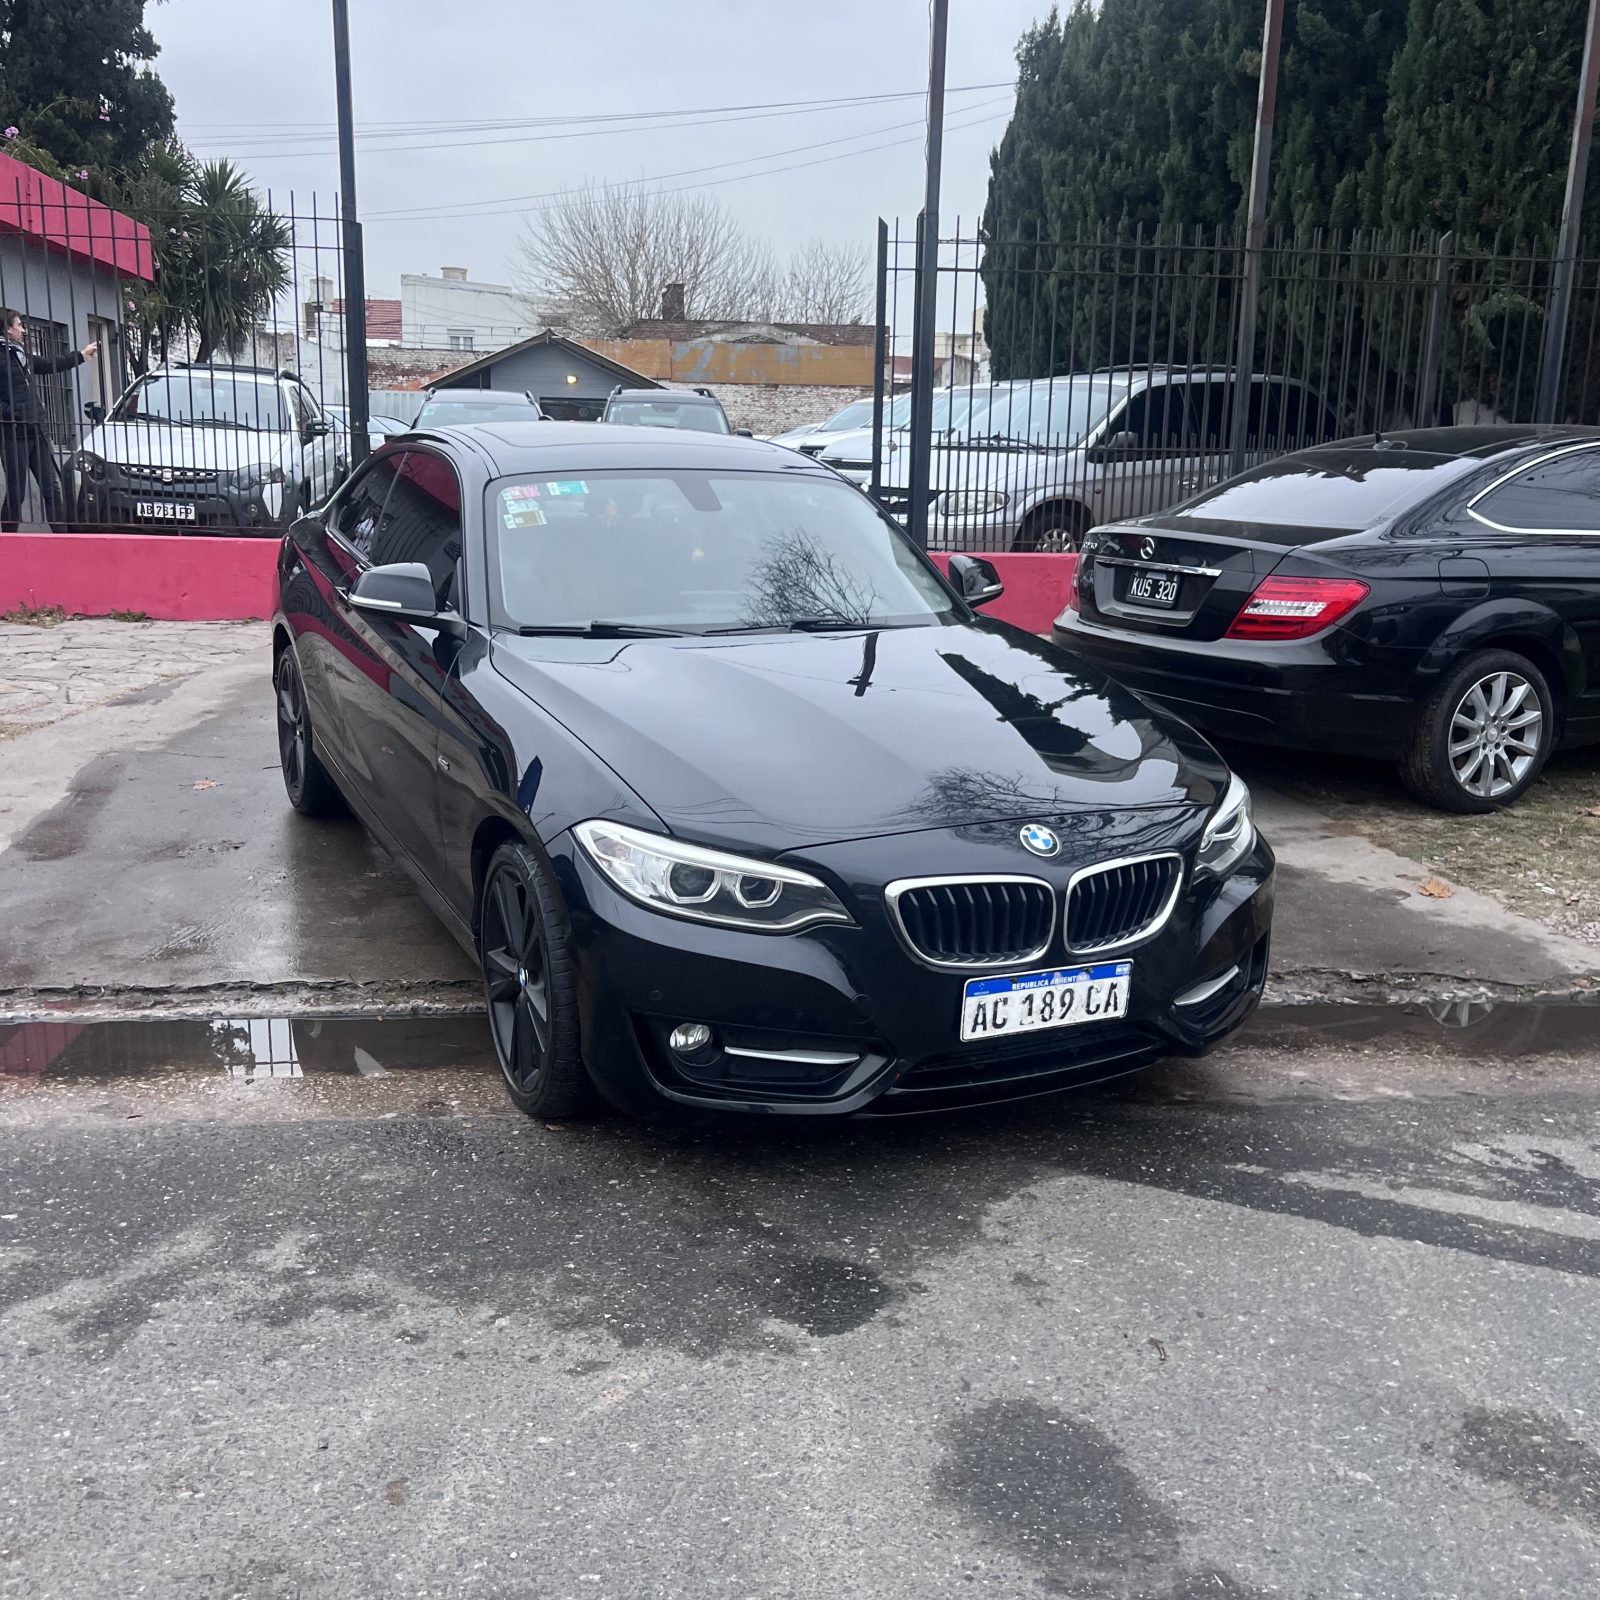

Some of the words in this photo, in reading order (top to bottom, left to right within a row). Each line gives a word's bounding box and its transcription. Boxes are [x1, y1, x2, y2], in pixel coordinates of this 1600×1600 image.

[1131, 577, 1152, 596] KUS
[1155, 581, 1177, 600] 320
[1012, 980, 1048, 990] REPUBLICA
[971, 997, 1008, 1032] AC
[1020, 988, 1074, 1025] 189
[1085, 982, 1118, 1015] CA
